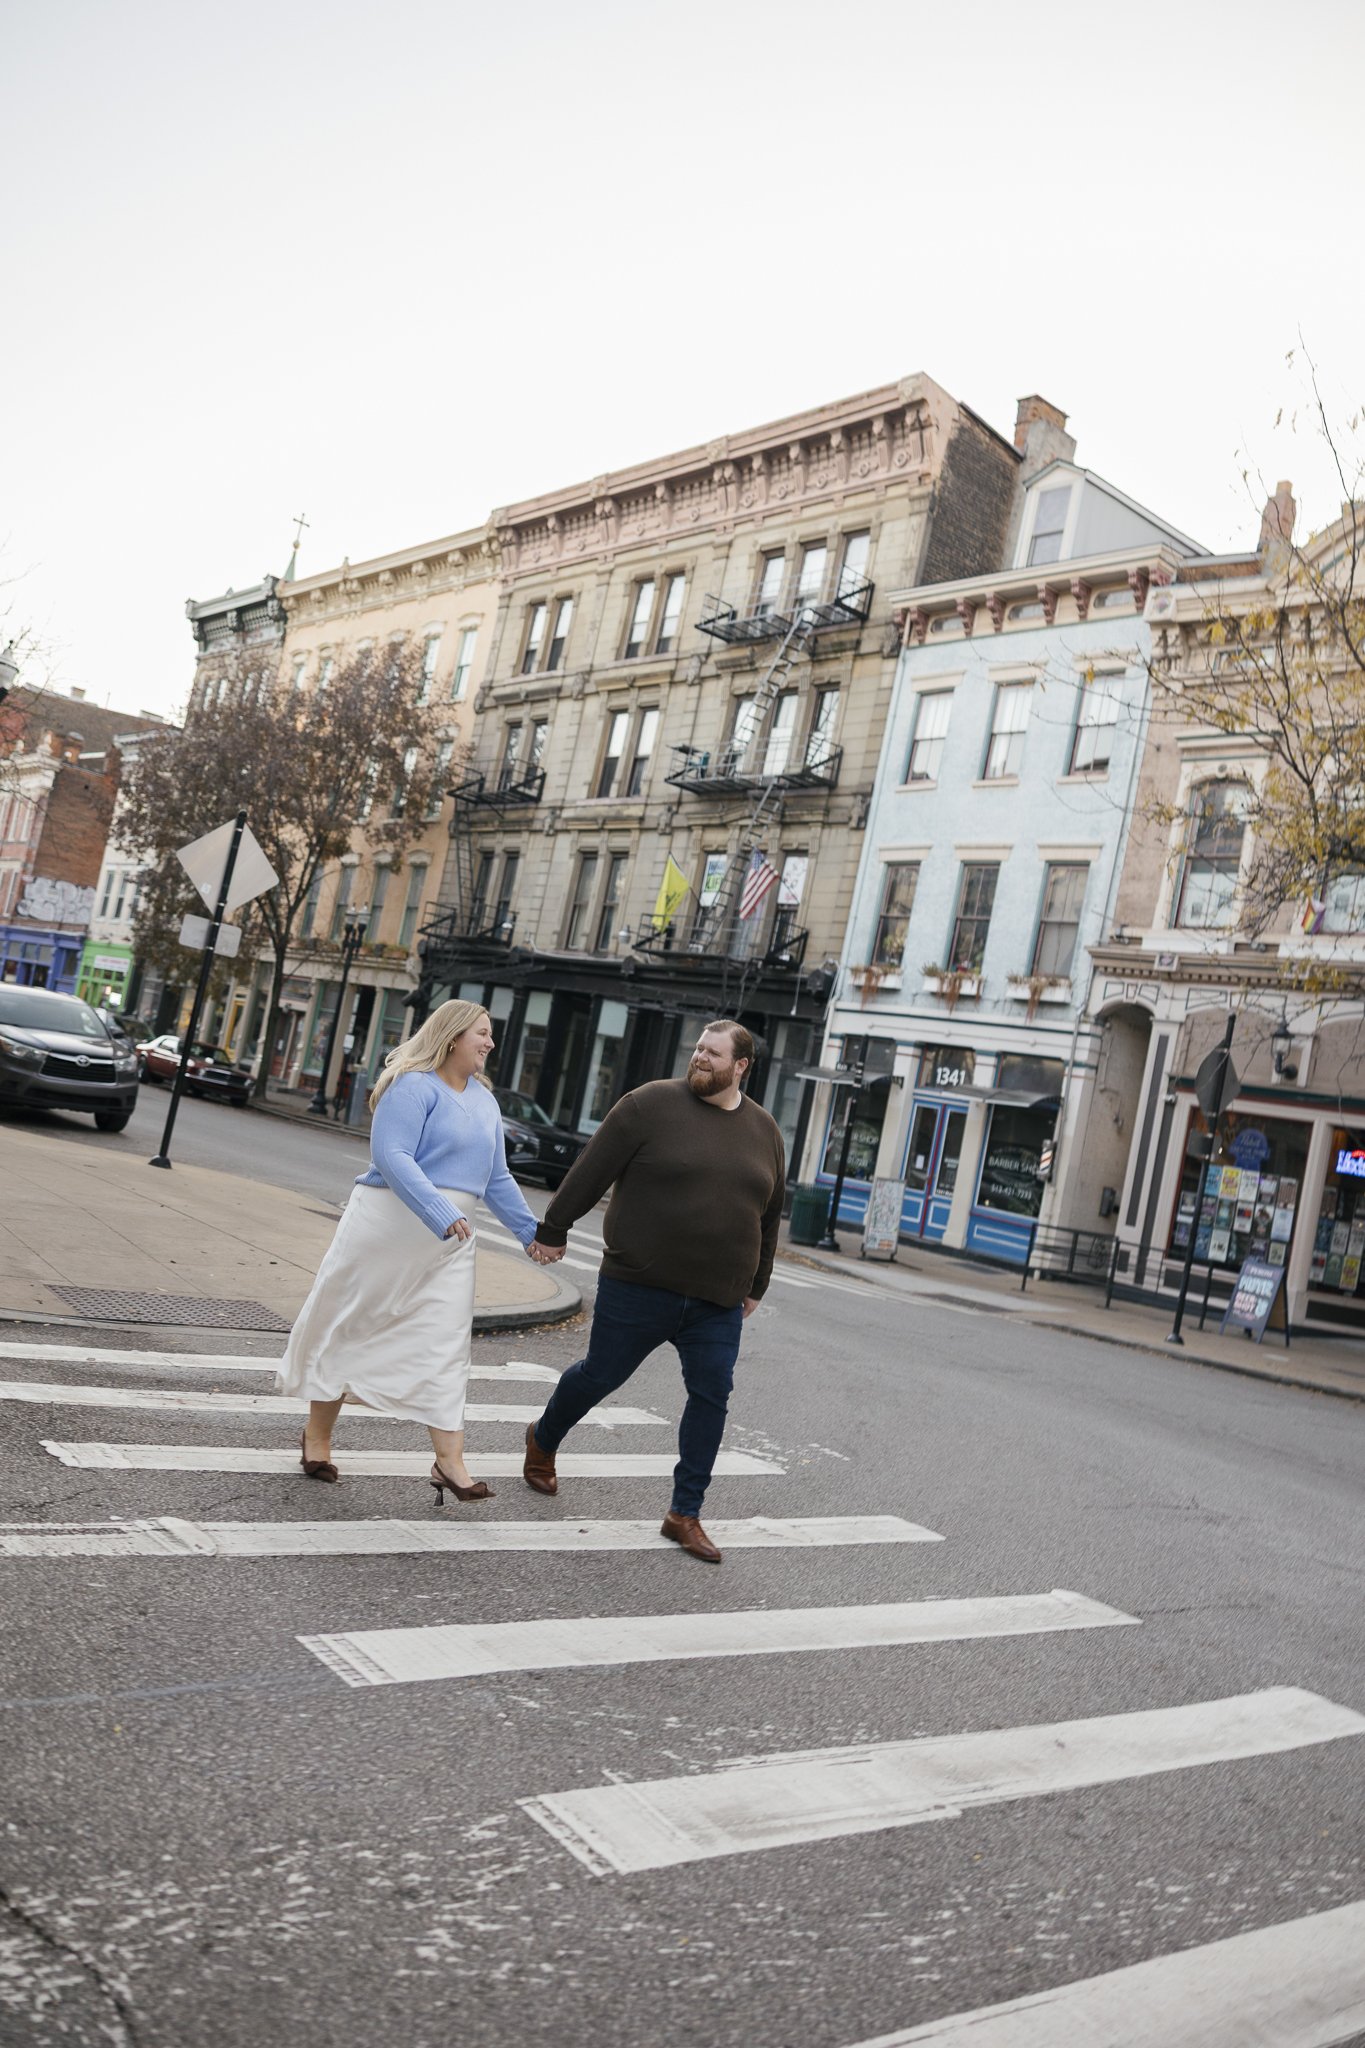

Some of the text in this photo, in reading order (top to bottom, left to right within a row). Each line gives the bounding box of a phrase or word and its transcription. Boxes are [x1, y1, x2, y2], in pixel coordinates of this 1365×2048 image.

[936, 1066, 966, 1086] 1341
[988, 1155, 1040, 1176] BARBER SHO
